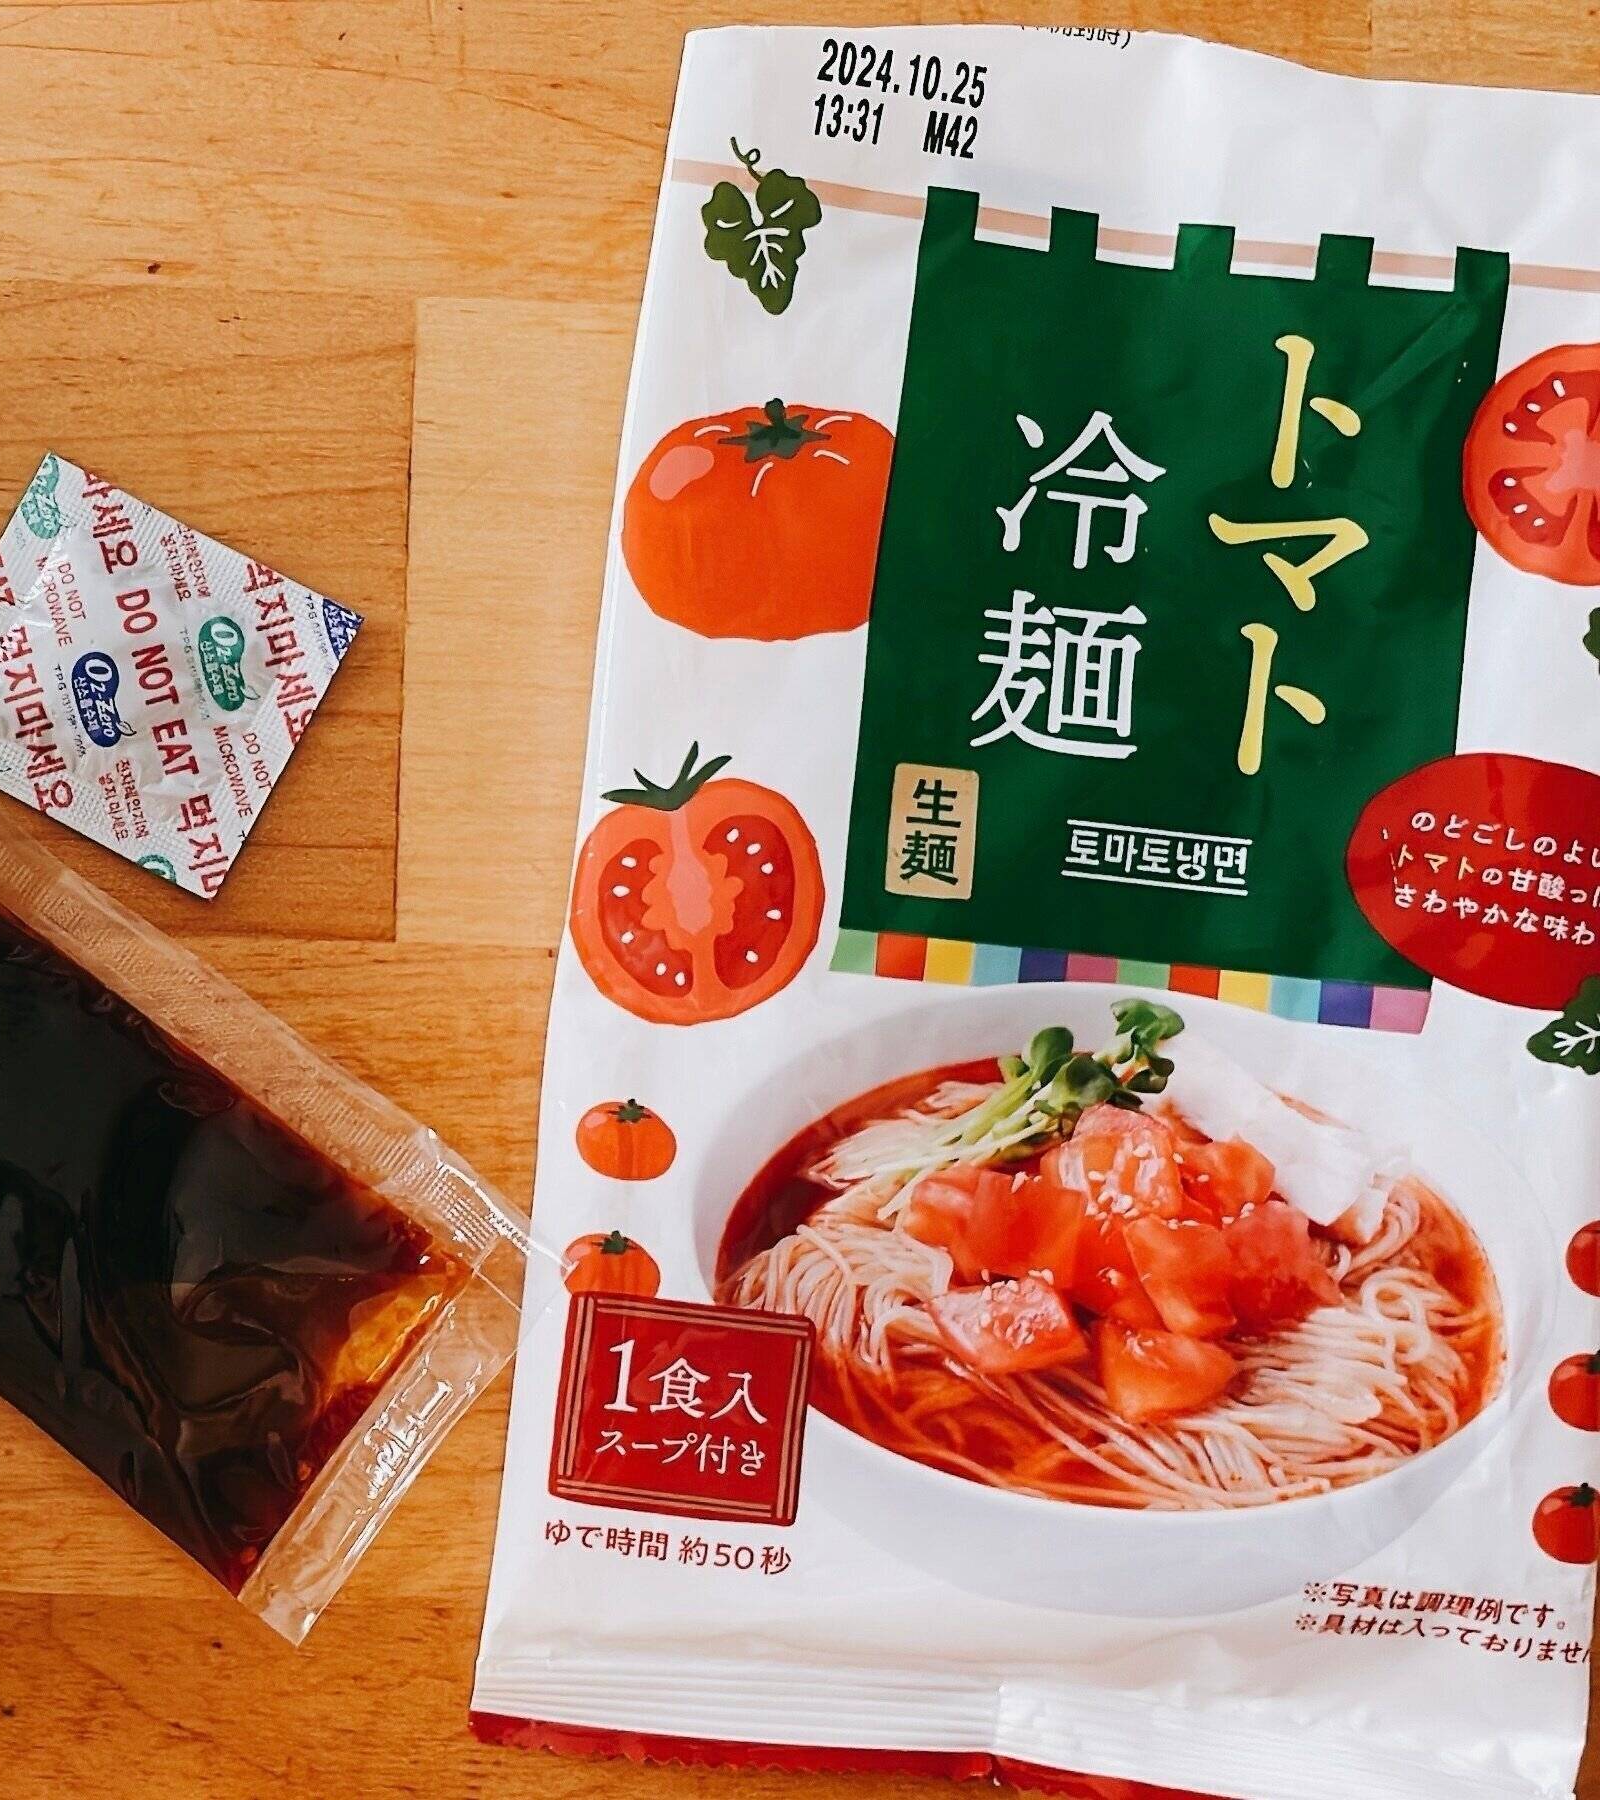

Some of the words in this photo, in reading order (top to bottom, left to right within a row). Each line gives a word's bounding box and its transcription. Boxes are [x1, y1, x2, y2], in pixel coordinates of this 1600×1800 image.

[817, 39, 988, 108] 2024.10.25
[812, 94, 884, 146] 13:31
[924, 111, 978, 159] M42
[57, 562, 76, 584] DO
[1208, 334, 1370, 776] トマト
[65, 589, 87, 620] NOT
[115, 588, 158, 634] DO
[970, 410, 1167, 760] 冷麺
[131, 643, 180, 706] NOT
[151, 718, 200, 776] EAT
[213, 725, 254, 818] MICROWAVE
[241, 732, 262, 755] DO
[251, 760, 272, 789] NOT
[899, 778, 962, 886] 生麺
[1065, 829, 1248, 885] 토마토냉면
[1397, 843, 1600, 909] トマトの甘酸っ
[603, 1338, 768, 1425] 1食入
[595, 1428, 766, 1477] スープ付き
[544, 1519, 668, 1562] ゆで時間
[678, 1534, 792, 1576] 約50秒
[1295, 1612, 1591, 1664] ※具材は入っておりませ
